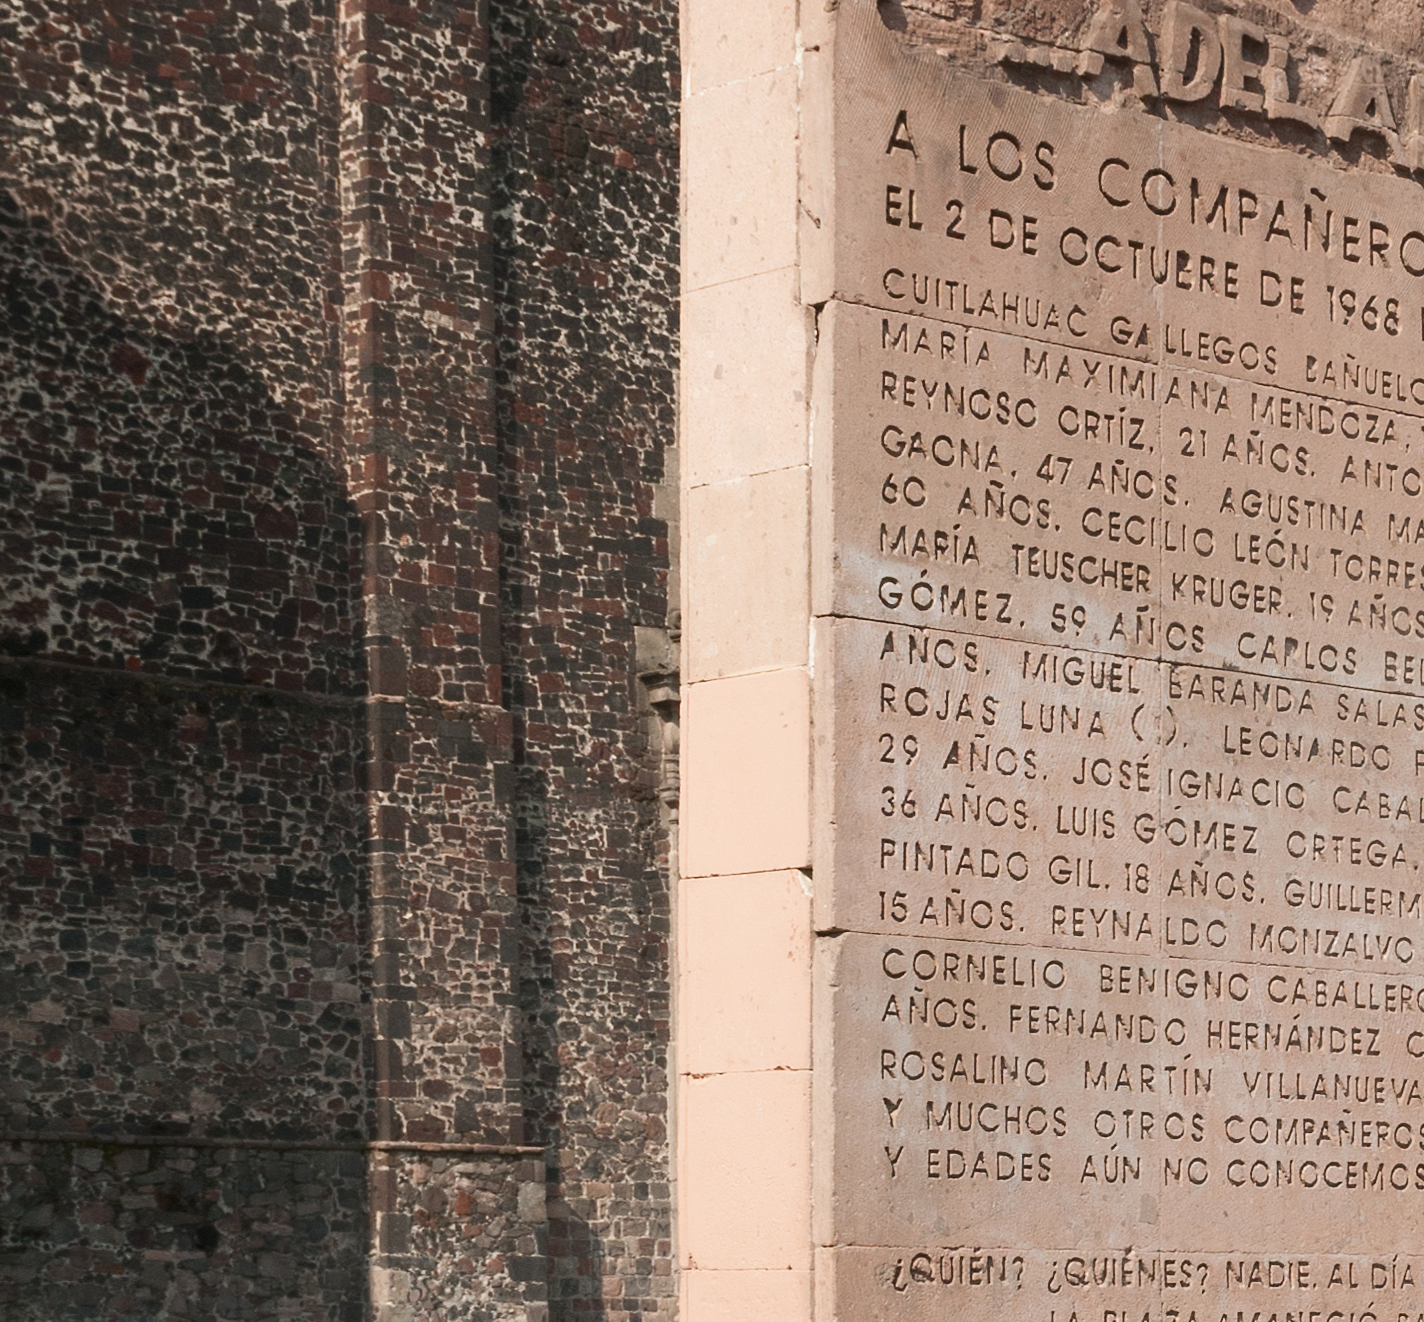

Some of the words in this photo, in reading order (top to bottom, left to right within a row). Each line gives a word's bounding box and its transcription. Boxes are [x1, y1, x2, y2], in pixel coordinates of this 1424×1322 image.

[885, 104, 919, 163] A
[958, 121, 1058, 195] LOS
[884, 184, 923, 233] EL
[944, 197, 967, 242] 2
[988, 207, 1038, 258] DE
[1058, 222, 1239, 301] OCTUBRE
[1259, 267, 1306, 316] DE
[1325, 282, 1400, 336] 1968
[1022, 346, 1233, 417] MAXIMIANA
[879, 369, 1038, 433] REYNOSO
[1177, 425, 1208, 463] 21
[880, 470, 927, 511] 60
[1080, 504, 1216, 557] CECILIO
[1234, 528, 1310, 572] LEÓN
[1035, 449, 1073, 489] 47
[1219, 482, 1366, 538] AGUSTINA
[1011, 542, 1152, 596] TEUSCHER
[1309, 590, 1334, 624] 19
[1050, 599, 1088, 639] 59
[1022, 649, 1141, 695] MIGUEL
[880, 682, 997, 727] ROJAS
[1020, 699, 1105, 740] LUNA
[878, 730, 919, 768] 29
[1072, 754, 1151, 794] JOSÉ
[1168, 765, 1305, 811] IGNACIO
[879, 785, 917, 821] 36
[1056, 804, 1116, 841] LUIS
[1133, 806, 1258, 855] GÓMEZ
[879, 838, 1030, 883] PINTADO
[1124, 862, 1151, 895] 18
[877, 890, 908, 926] 15
[1249, 921, 1414, 965] MONZALVO
[881, 947, 1068, 993] CORNELIO
[1099, 962, 1251, 1004] BENIGNO
[1008, 1001, 1186, 1045] FERNANDO
[1207, 1013, 1381, 1056] HERNÁNDEZ
[880, 1048, 1048, 1089] ROSALINO
[1083, 1054, 1214, 1097] MARTÍN
[883, 1097, 904, 1130] Y
[925, 1099, 1069, 1137] MUCHOS
[1093, 1107, 1206, 1143] OTROS
[883, 1146, 905, 1180] Y
[926, 1148, 1052, 1183] EDADES
[1080, 1144, 1141, 1185] AÚN
[1164, 1154, 1209, 1187] NO
[1327, 1259, 1359, 1290] AL
[1370, 1255, 1415, 1290] DÍA
